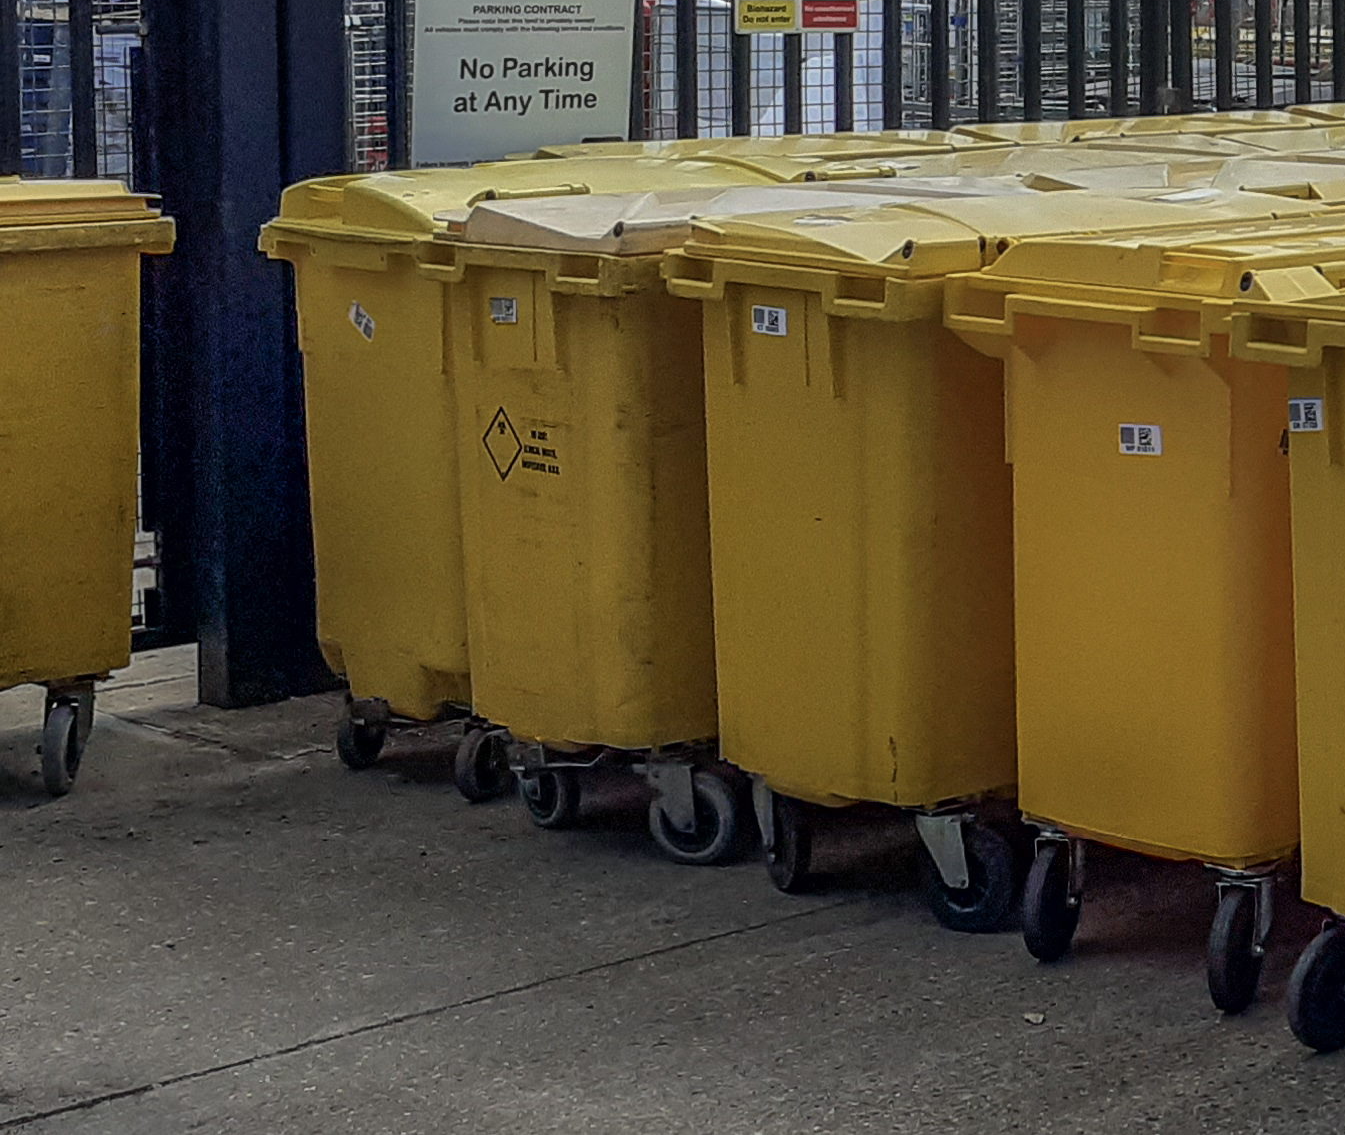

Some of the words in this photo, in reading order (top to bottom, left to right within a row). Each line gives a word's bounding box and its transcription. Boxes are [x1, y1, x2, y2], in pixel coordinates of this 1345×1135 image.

[473, 5, 521, 14] PARKING
[524, 4, 582, 14] CONTRACT
[747, 4, 787, 13] Biohazard
[743, 15, 754, 23] Do
[756, 15, 769, 23] not
[771, 15, 791, 23] enter
[460, 58, 495, 79] No
[503, 56, 594, 81] Parking
[453, 92, 478, 113] at
[484, 90, 532, 116] Any
[538, 89, 598, 109] Time
